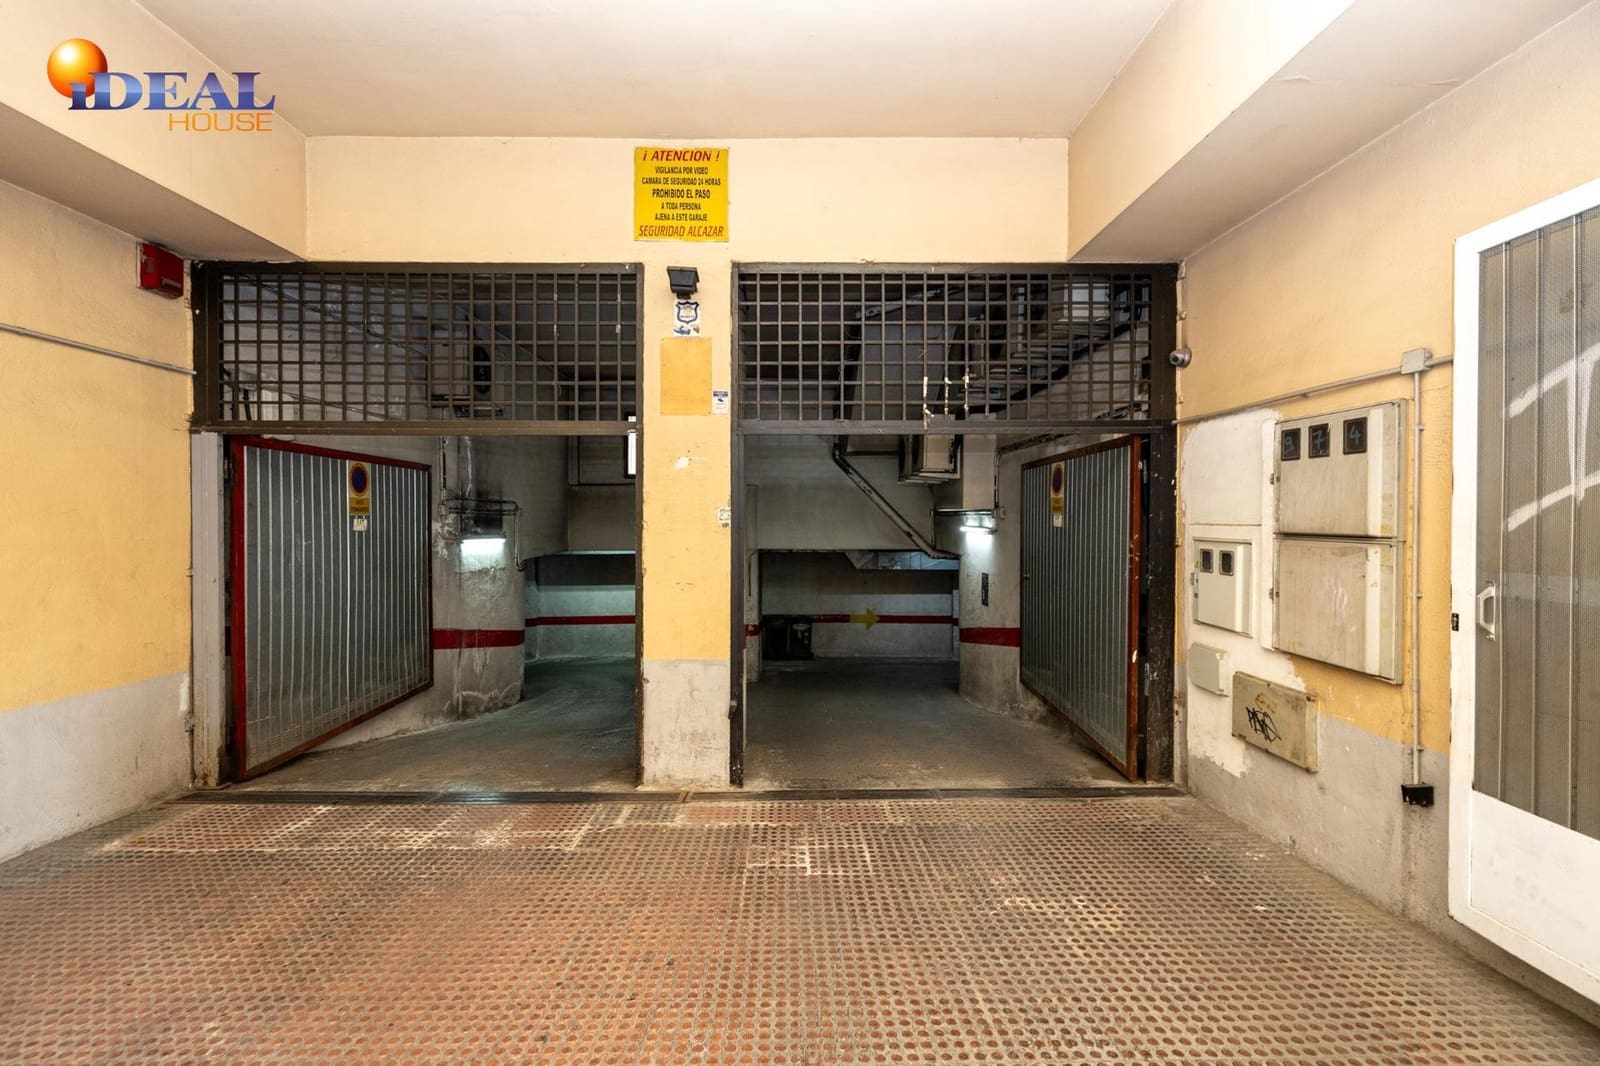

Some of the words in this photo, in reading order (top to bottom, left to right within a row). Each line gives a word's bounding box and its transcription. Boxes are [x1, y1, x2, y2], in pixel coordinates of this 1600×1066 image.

[650, 150, 712, 162] ATENCION
[655, 166, 682, 175] VIGILANCIA
[683, 167, 693, 175] POR
[694, 167, 709, 175] VIDEO
[641, 177, 662, 185] CAMARA
[662, 177, 669, 185] DE
[670, 177, 697, 186] SEGURIDAD
[698, 178, 704, 186] 24
[705, 178, 721, 186] HORAS
[652, 188, 685, 199] PROHIBIDO
[686, 189, 694, 199] EL
[695, 189, 711, 199] PASO
[661, 202, 665, 210] A
[666, 202, 678, 210] TODA
[679, 202, 701, 211] PERSONA
[655, 213, 671, 221] AJENA
[671, 213, 675, 221] A
[676, 213, 688, 221] ESTE
[689, 213, 708, 222] GARAJE
[638, 224, 685, 237] SEGURIDAD
[687, 225, 724, 238] ALCAZAR
[1312, 430, 1325, 449] 7
[1348, 425, 1361, 447] 4
